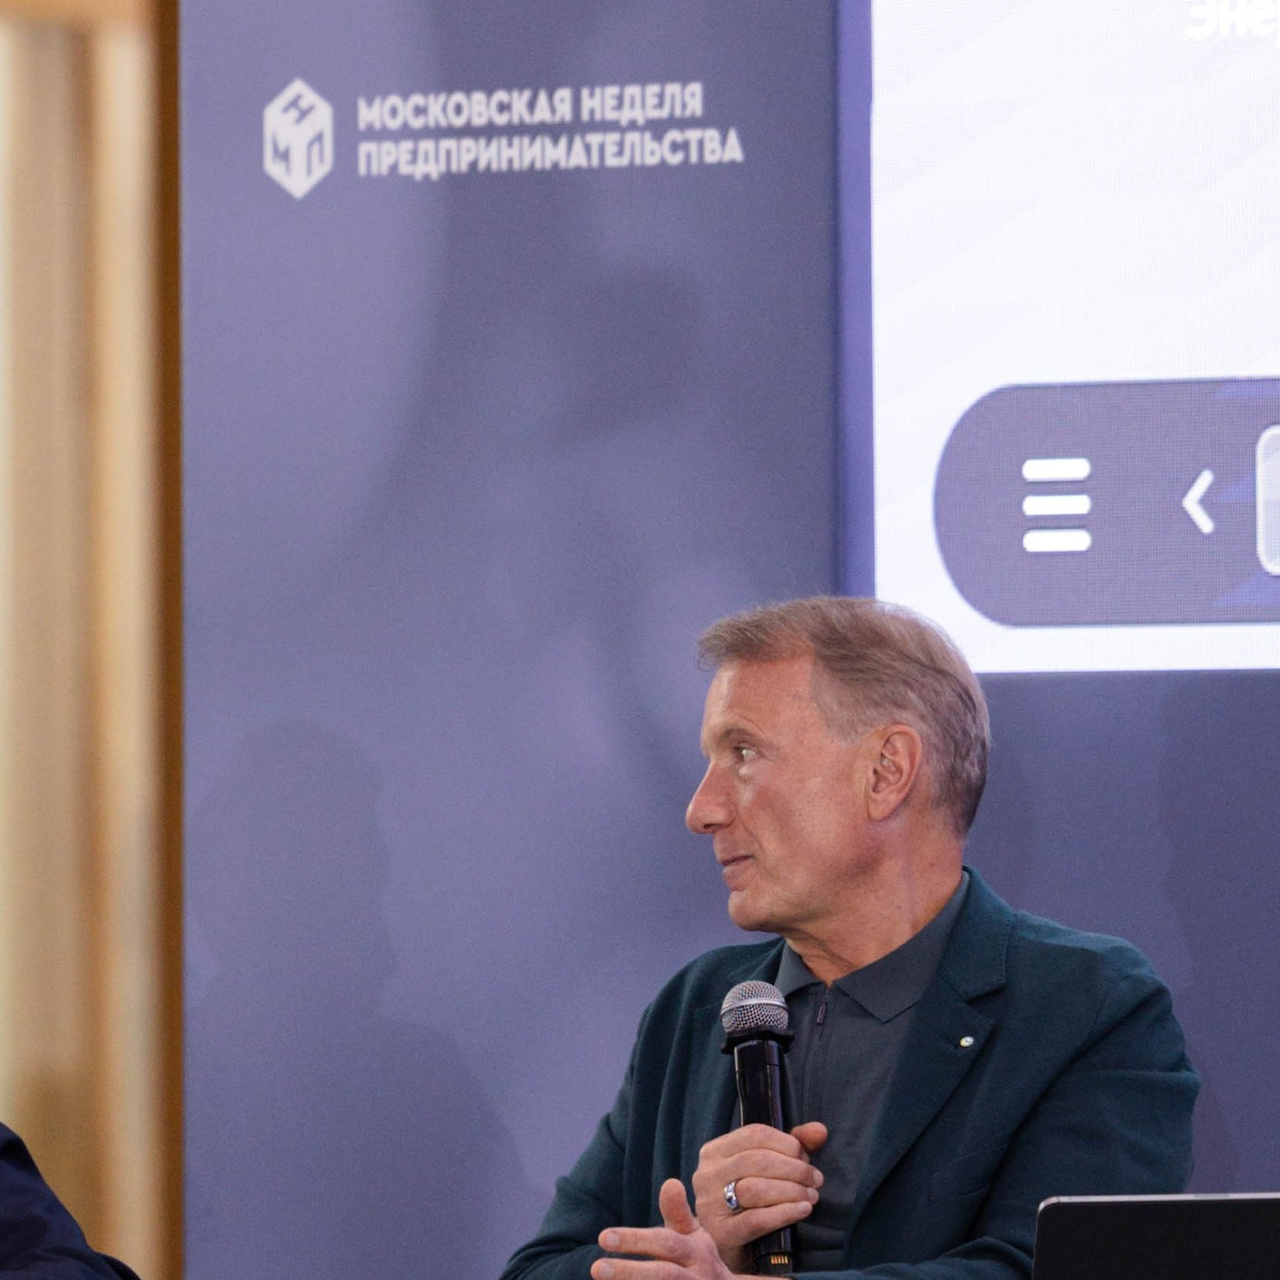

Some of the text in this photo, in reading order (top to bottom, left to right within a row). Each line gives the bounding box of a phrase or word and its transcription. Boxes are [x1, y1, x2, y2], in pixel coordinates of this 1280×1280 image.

[357, 81, 704, 131] МОСКОВСКАЯ НЕДЕЛЯ
[357, 127, 744, 181] ПРЕДПРИНИМАТЕЛЬСТВА
